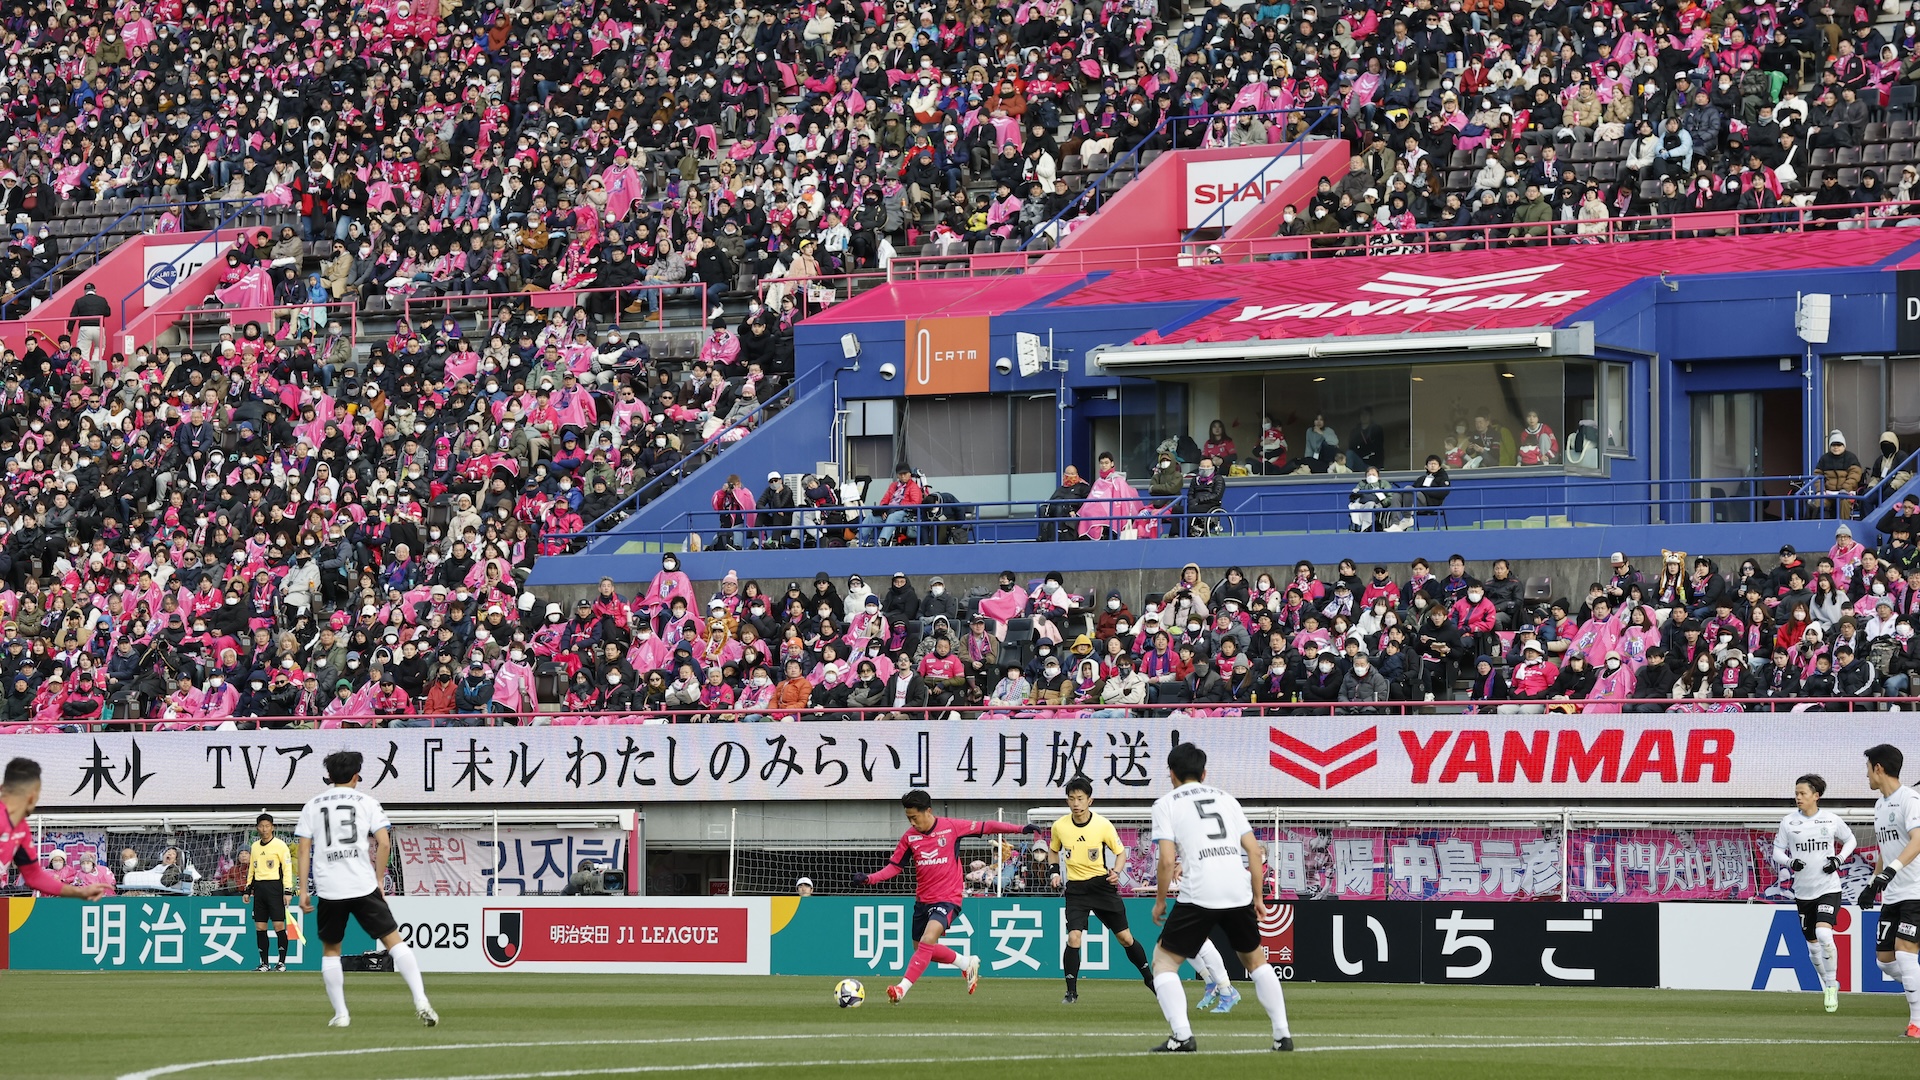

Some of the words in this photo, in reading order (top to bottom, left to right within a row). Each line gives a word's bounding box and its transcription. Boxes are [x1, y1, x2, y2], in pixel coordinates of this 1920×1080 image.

[1229, 289, 1591, 322] YANMAR
[1727, 668, 1734, 680] 8
[206, 735, 545, 792] TVアメ『未ル
[1398, 729, 1736, 783] YANMAR
[320, 805, 358, 847] 13
[1194, 798, 1227, 840] 5
[326, 849, 359, 862] HIRAOKA
[1391, 838, 1563, 895] 中島元彦
[1570, 839, 1753, 895] 上門知樹
[399, 922, 470, 949] 2025
[550, 924, 609, 944] 明治安田
[616, 926, 635, 944] J1
[641, 926, 719, 944] LEAGUE
[1332, 908, 1603, 981] いちご
